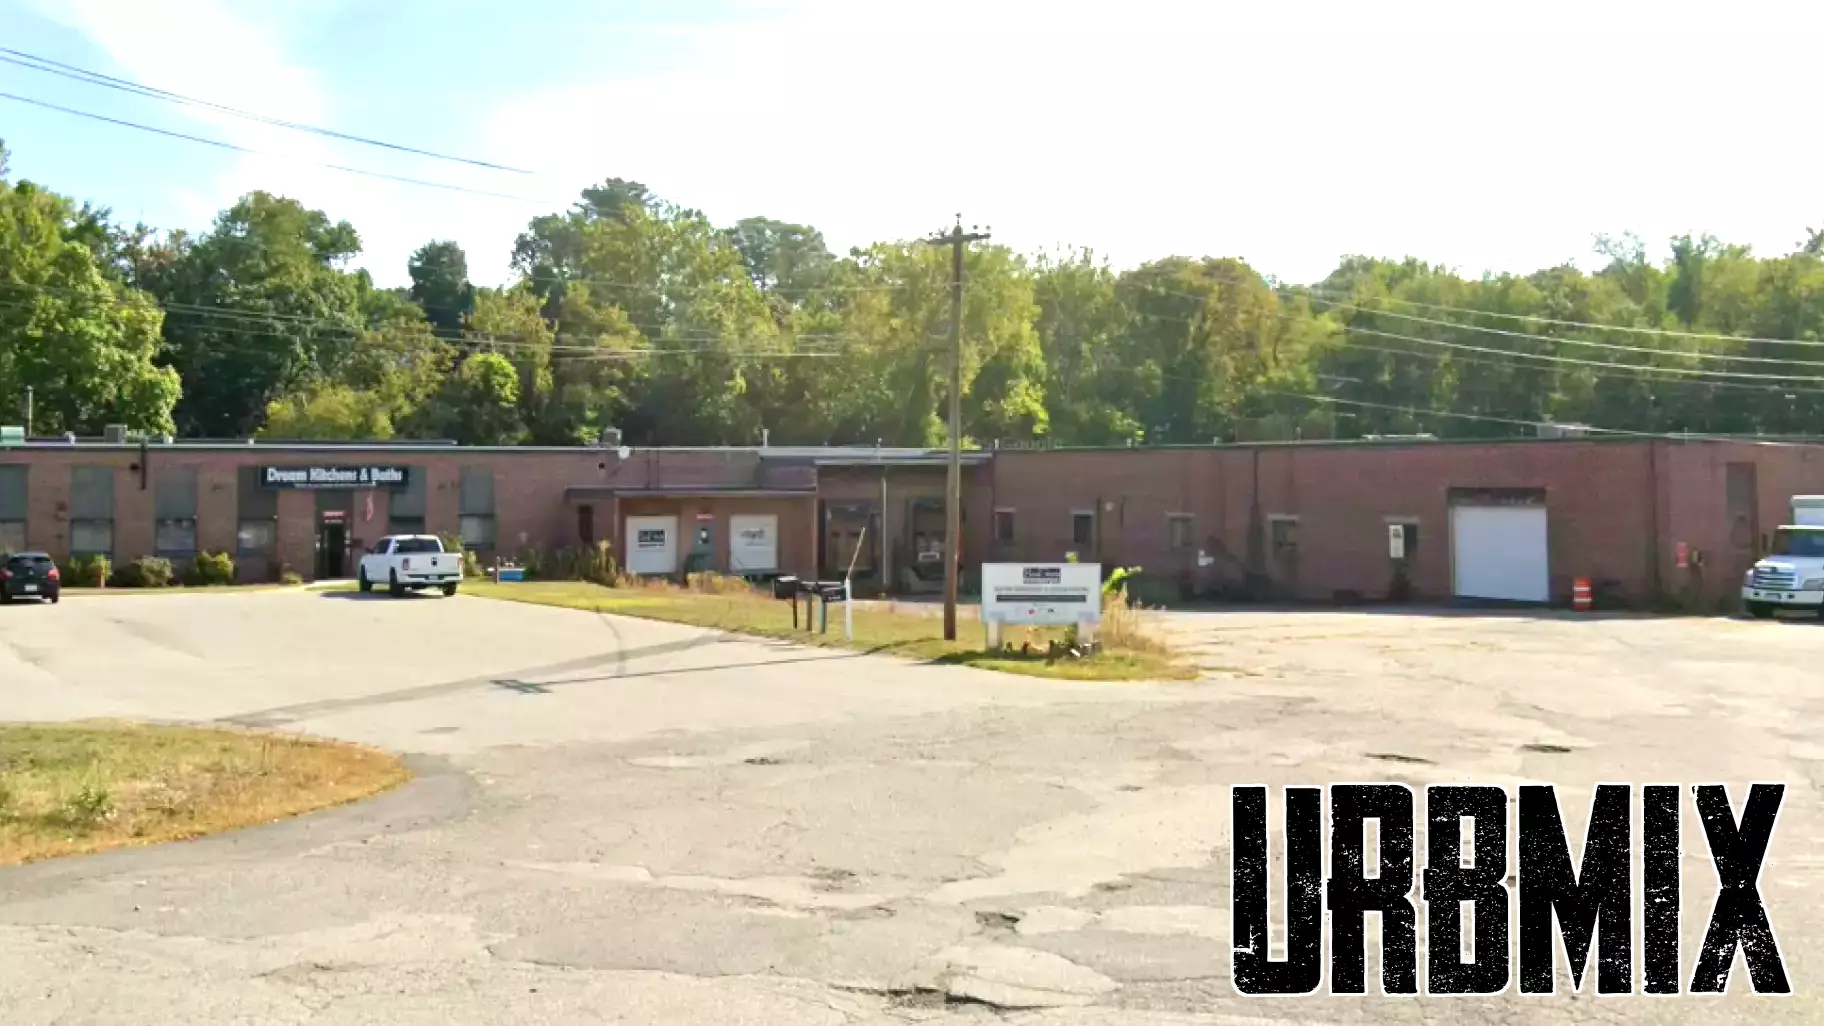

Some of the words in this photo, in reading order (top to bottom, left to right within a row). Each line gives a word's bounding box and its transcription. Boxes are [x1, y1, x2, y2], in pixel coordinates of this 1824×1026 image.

[266, 466, 307, 482] Dream
[309, 467, 357, 482] Kitchens
[359, 467, 369, 482] &
[371, 466, 402, 482] Baths
